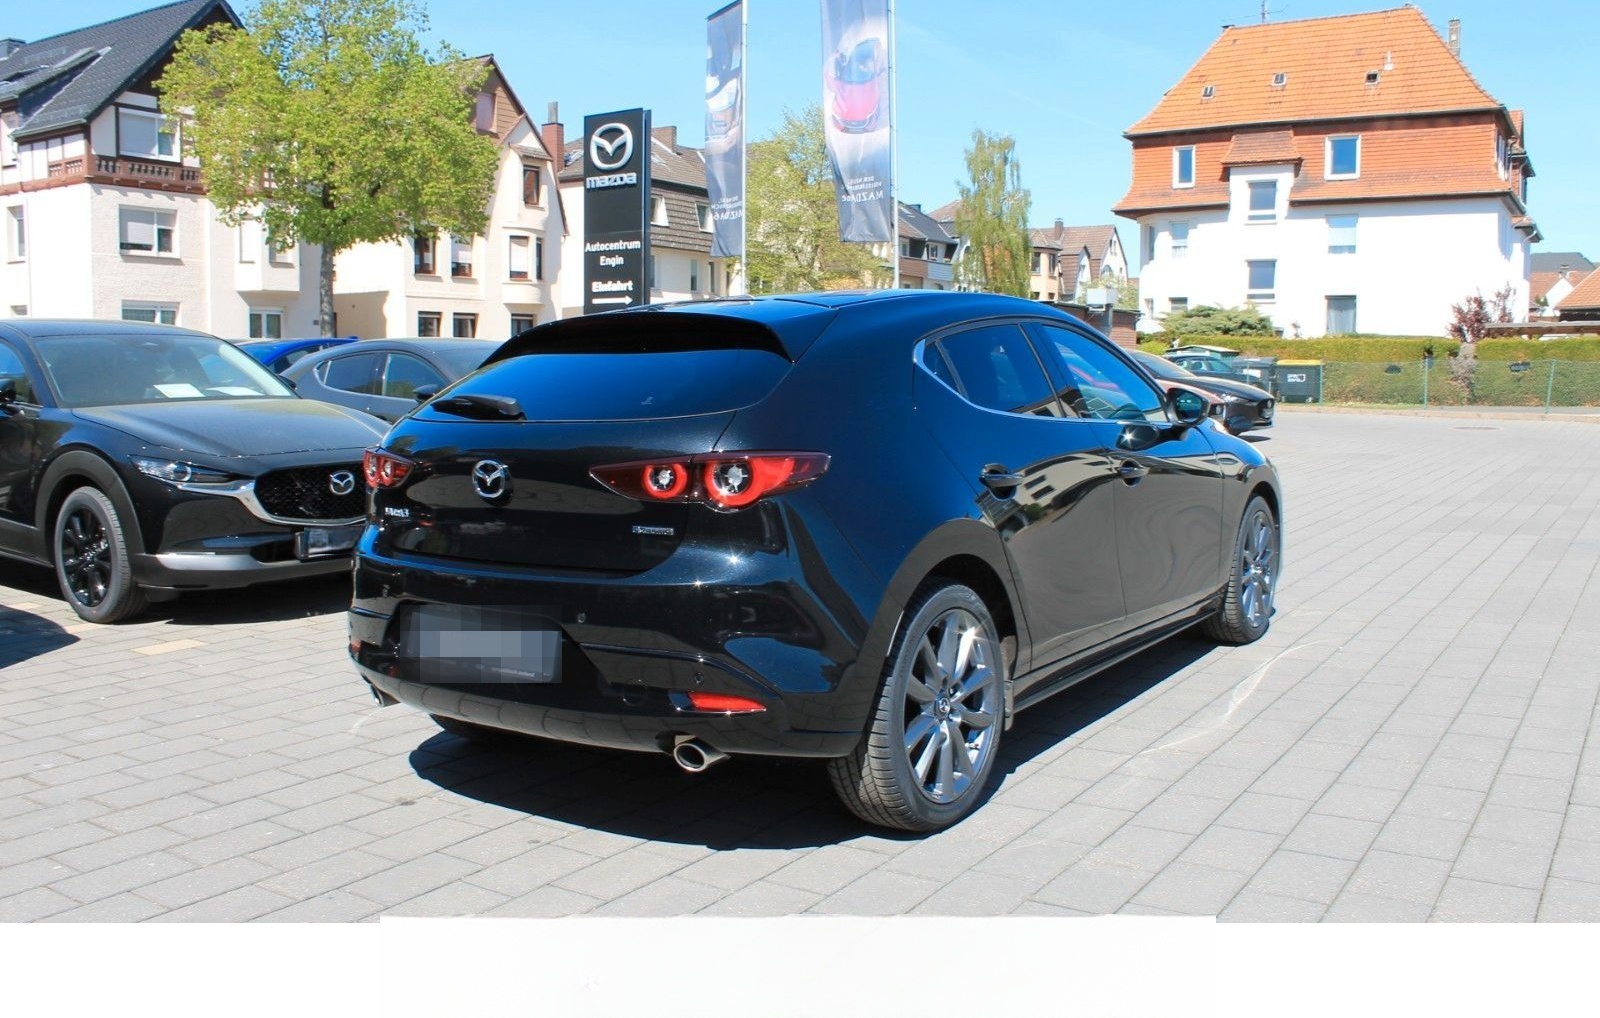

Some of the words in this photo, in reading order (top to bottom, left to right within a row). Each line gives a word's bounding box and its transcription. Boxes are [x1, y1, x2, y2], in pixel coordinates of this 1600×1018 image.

[585, 240, 641, 252] Autocentrum
[599, 255, 625, 267] Engin
[592, 280, 634, 293] Einfahrt
